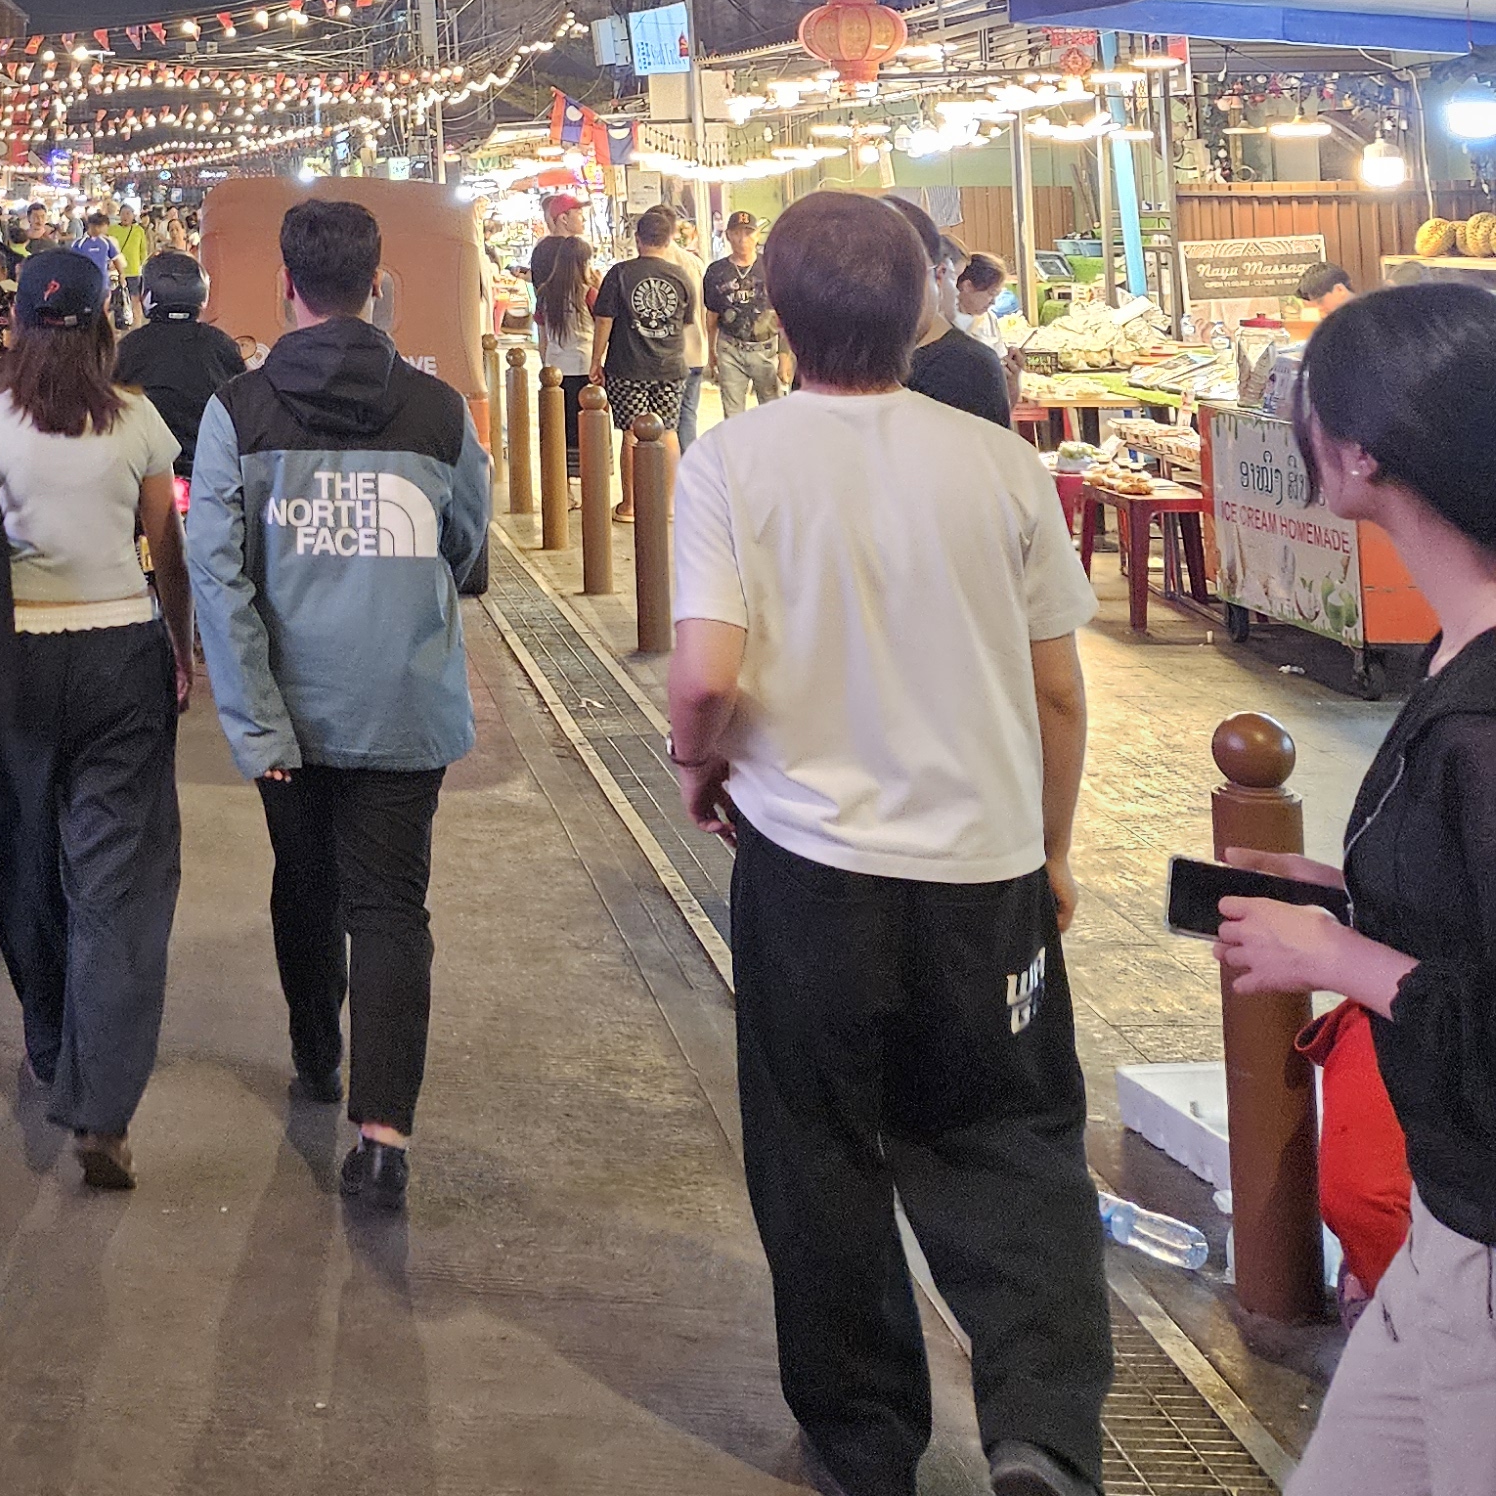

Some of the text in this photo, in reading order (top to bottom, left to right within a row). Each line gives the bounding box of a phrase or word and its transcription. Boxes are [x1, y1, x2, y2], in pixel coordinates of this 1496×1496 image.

[313, 471, 377, 500] THE
[267, 497, 378, 529] NORTH
[1221, 500, 1351, 554] ICE CREAM HOMEMADE
[296, 524, 378, 557] FACE
